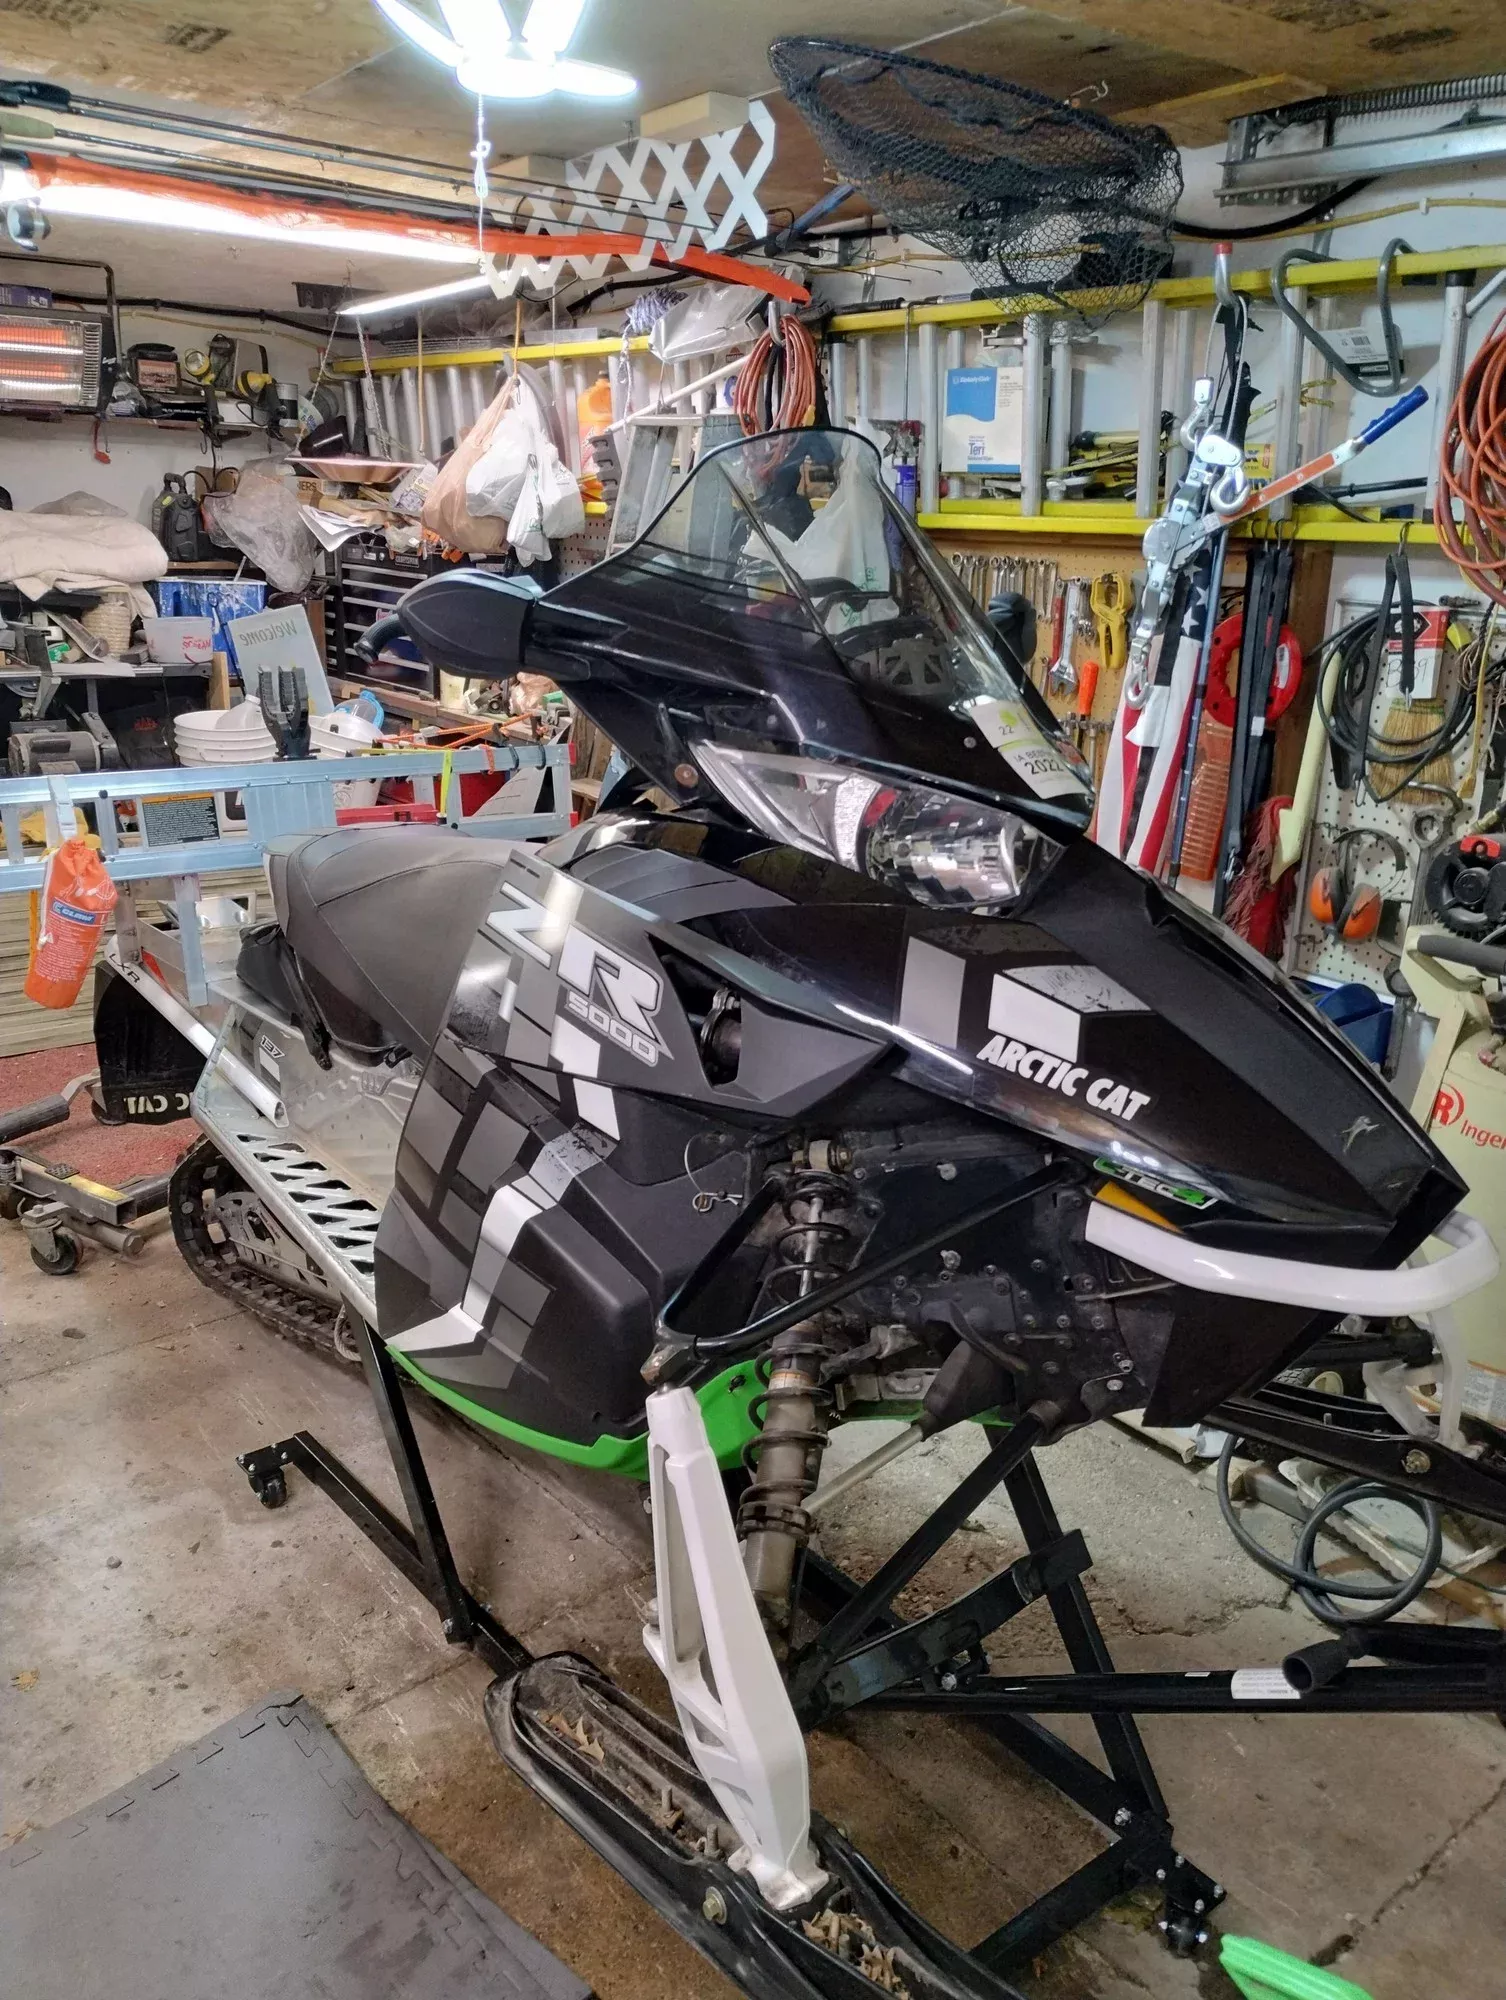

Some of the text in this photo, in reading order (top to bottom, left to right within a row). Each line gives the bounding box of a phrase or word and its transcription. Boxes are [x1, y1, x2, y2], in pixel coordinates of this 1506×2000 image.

[968, 443, 985, 456] Teri
[998, 725, 1015, 736] 22
[1024, 759, 1064, 776] 2022
[109, 953, 140, 983] LXR
[566, 989, 658, 1066] 5000
[259, 1034, 285, 1059] 137
[976, 1034, 1151, 1121] ARCTIC CAT
